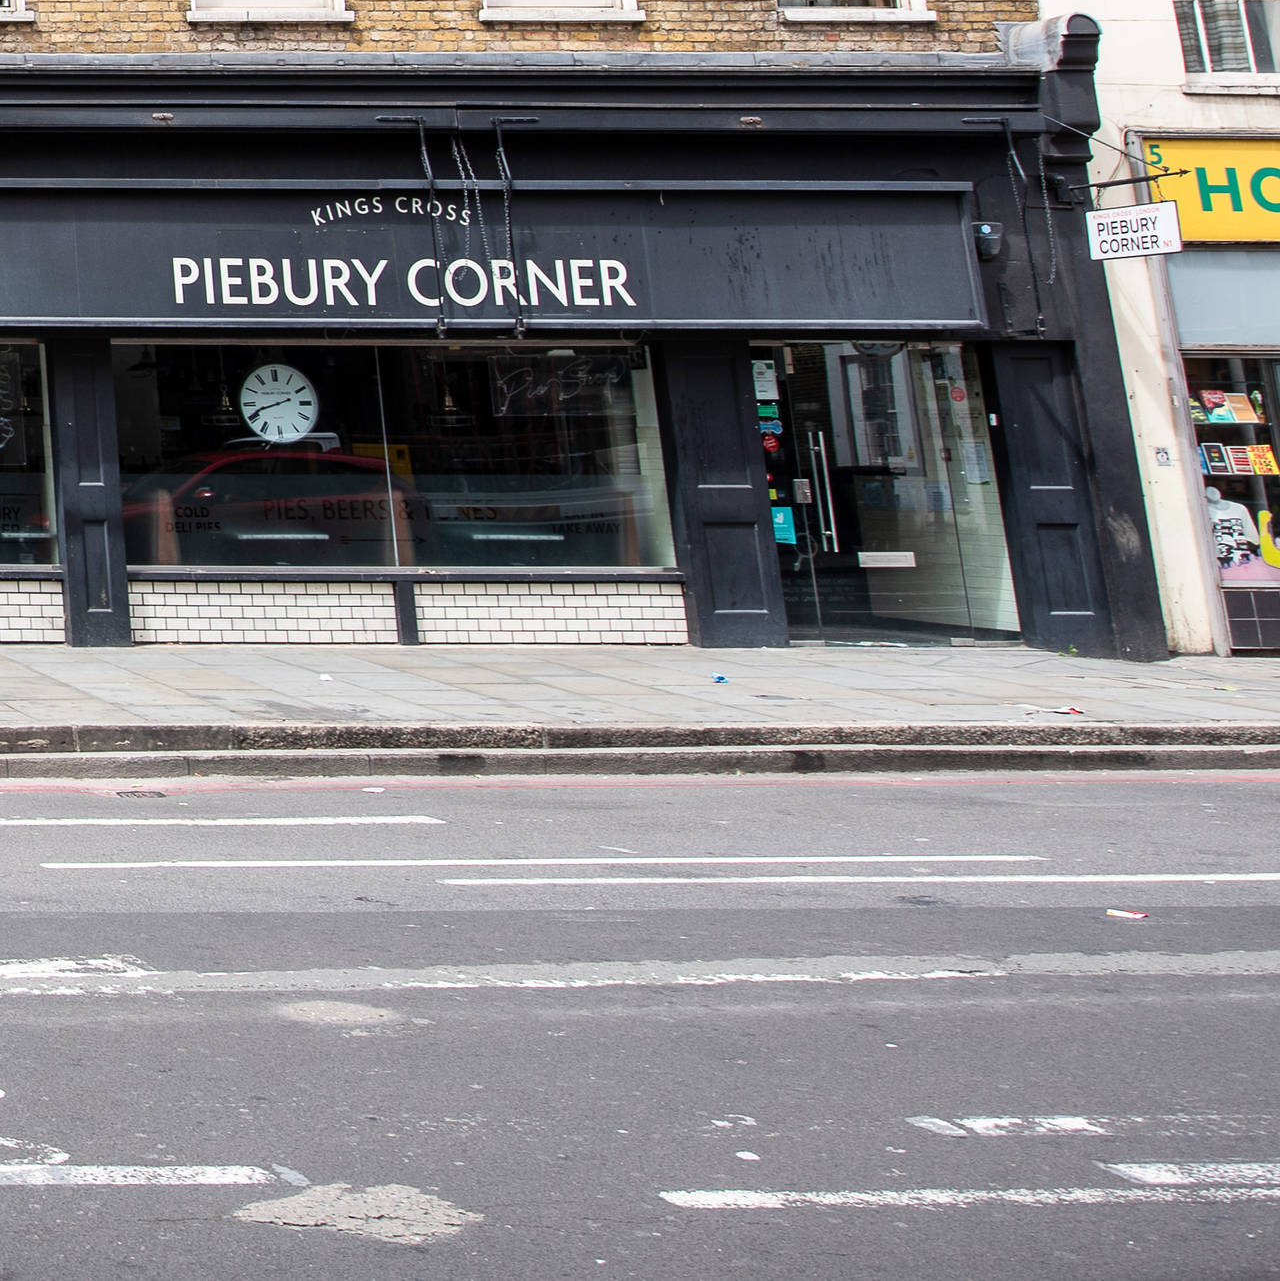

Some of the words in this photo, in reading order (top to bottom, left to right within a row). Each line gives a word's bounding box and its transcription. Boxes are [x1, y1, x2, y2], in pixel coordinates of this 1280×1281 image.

[1148, 144, 1163, 165] 5
[311, 197, 383, 227] KINGS
[395, 197, 472, 226] CROSS
[1096, 216, 1157, 237] PIEBURY
[1099, 235, 1160, 254] CORNER
[172, 257, 389, 306] PIEBURY
[406, 258, 637, 307] CORNER
[175, 506, 209, 518] COLD
[263, 499, 315, 522] PIES,
[322, 499, 389, 521] BEERS
[551, 523, 582, 535] TAKE
[584, 523, 620, 535] AWAY
